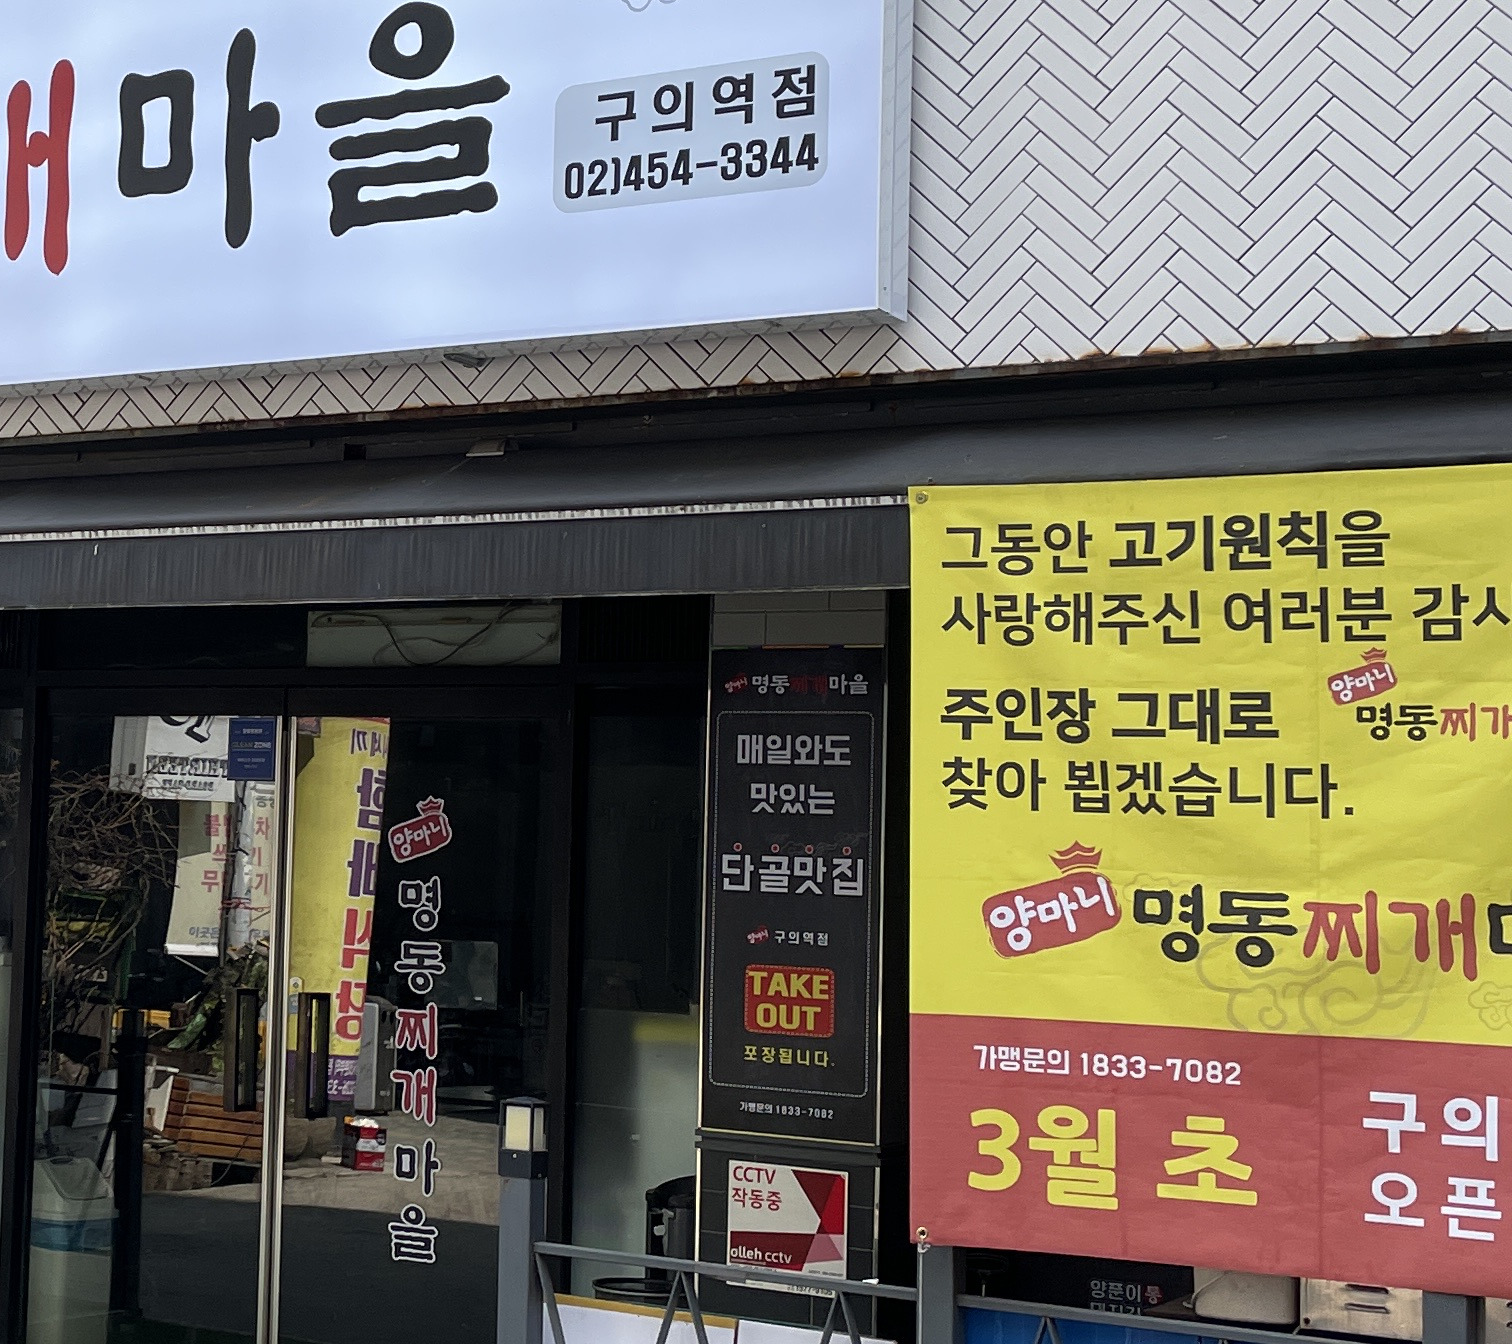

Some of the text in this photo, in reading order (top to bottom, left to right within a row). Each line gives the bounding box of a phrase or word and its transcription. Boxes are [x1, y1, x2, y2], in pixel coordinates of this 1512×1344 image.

[564, 133, 819, 199] 02)454-3344
[941, 511, 1393, 575] 그동안 고기원칙을
[941, 590, 1202, 648] 사랑해주신
[1223, 587, 1394, 645] 여러분
[1330, 663, 1395, 703] 양마니
[940, 688, 1280, 744] 주인장 그대로
[736, 734, 851, 766] 매일와도
[750, 783, 835, 814] 맛있는
[940, 758, 1356, 820] 찾아 뵙겠습니다.
[392, 817, 448, 857] 양마니
[721, 854, 864, 897] 단골맛집
[987, 874, 1116, 953] 양마니
[748, 971, 830, 1000] TAKE
[756, 1003, 822, 1031] OUT
[973, 1043, 1243, 1086] 가맹문의 1833-7082
[1362, 1091, 1499, 1162] 구의
[733, 1165, 777, 1185] CCTV
[968, 1103, 1259, 1211] 3월 초
[731, 1187, 783, 1212] 작동중
[1364, 1170, 1502, 1241] 오픈
[730, 1245, 793, 1264] olleh cctv
[1090, 1280, 1141, 1303] 양푼이
